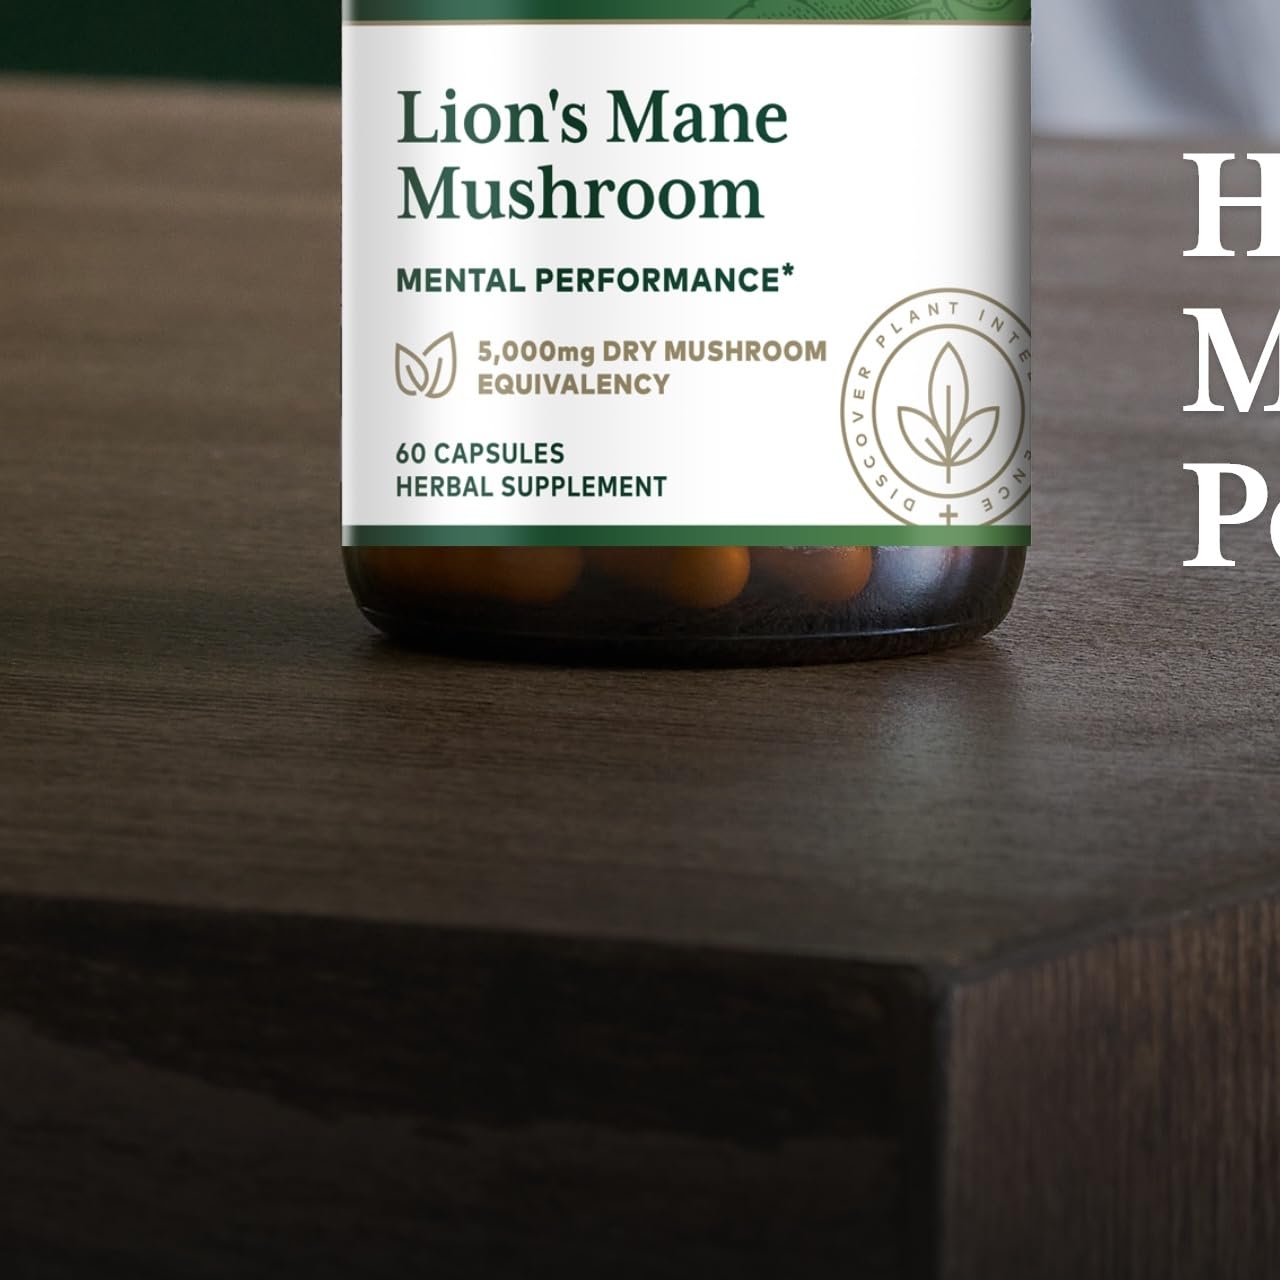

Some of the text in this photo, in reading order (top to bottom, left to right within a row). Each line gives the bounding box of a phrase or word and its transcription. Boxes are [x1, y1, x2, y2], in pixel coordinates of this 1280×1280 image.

[397, 89, 788, 143] Lion's Mane
[397, 165, 765, 219] Mushroom
[397, 268, 526, 292] MENTAL
[876, 302, 958, 348] PLANT
[478, 340, 827, 366] 5,000mg DRY MUSHROOM
[478, 373, 671, 396] EQUIVALENCY
[852, 366, 915, 511] DISCOVER
[396, 442, 565, 464] 60 CAPSULES
[396, 475, 667, 497] HERBAL SUPPLEMENT
